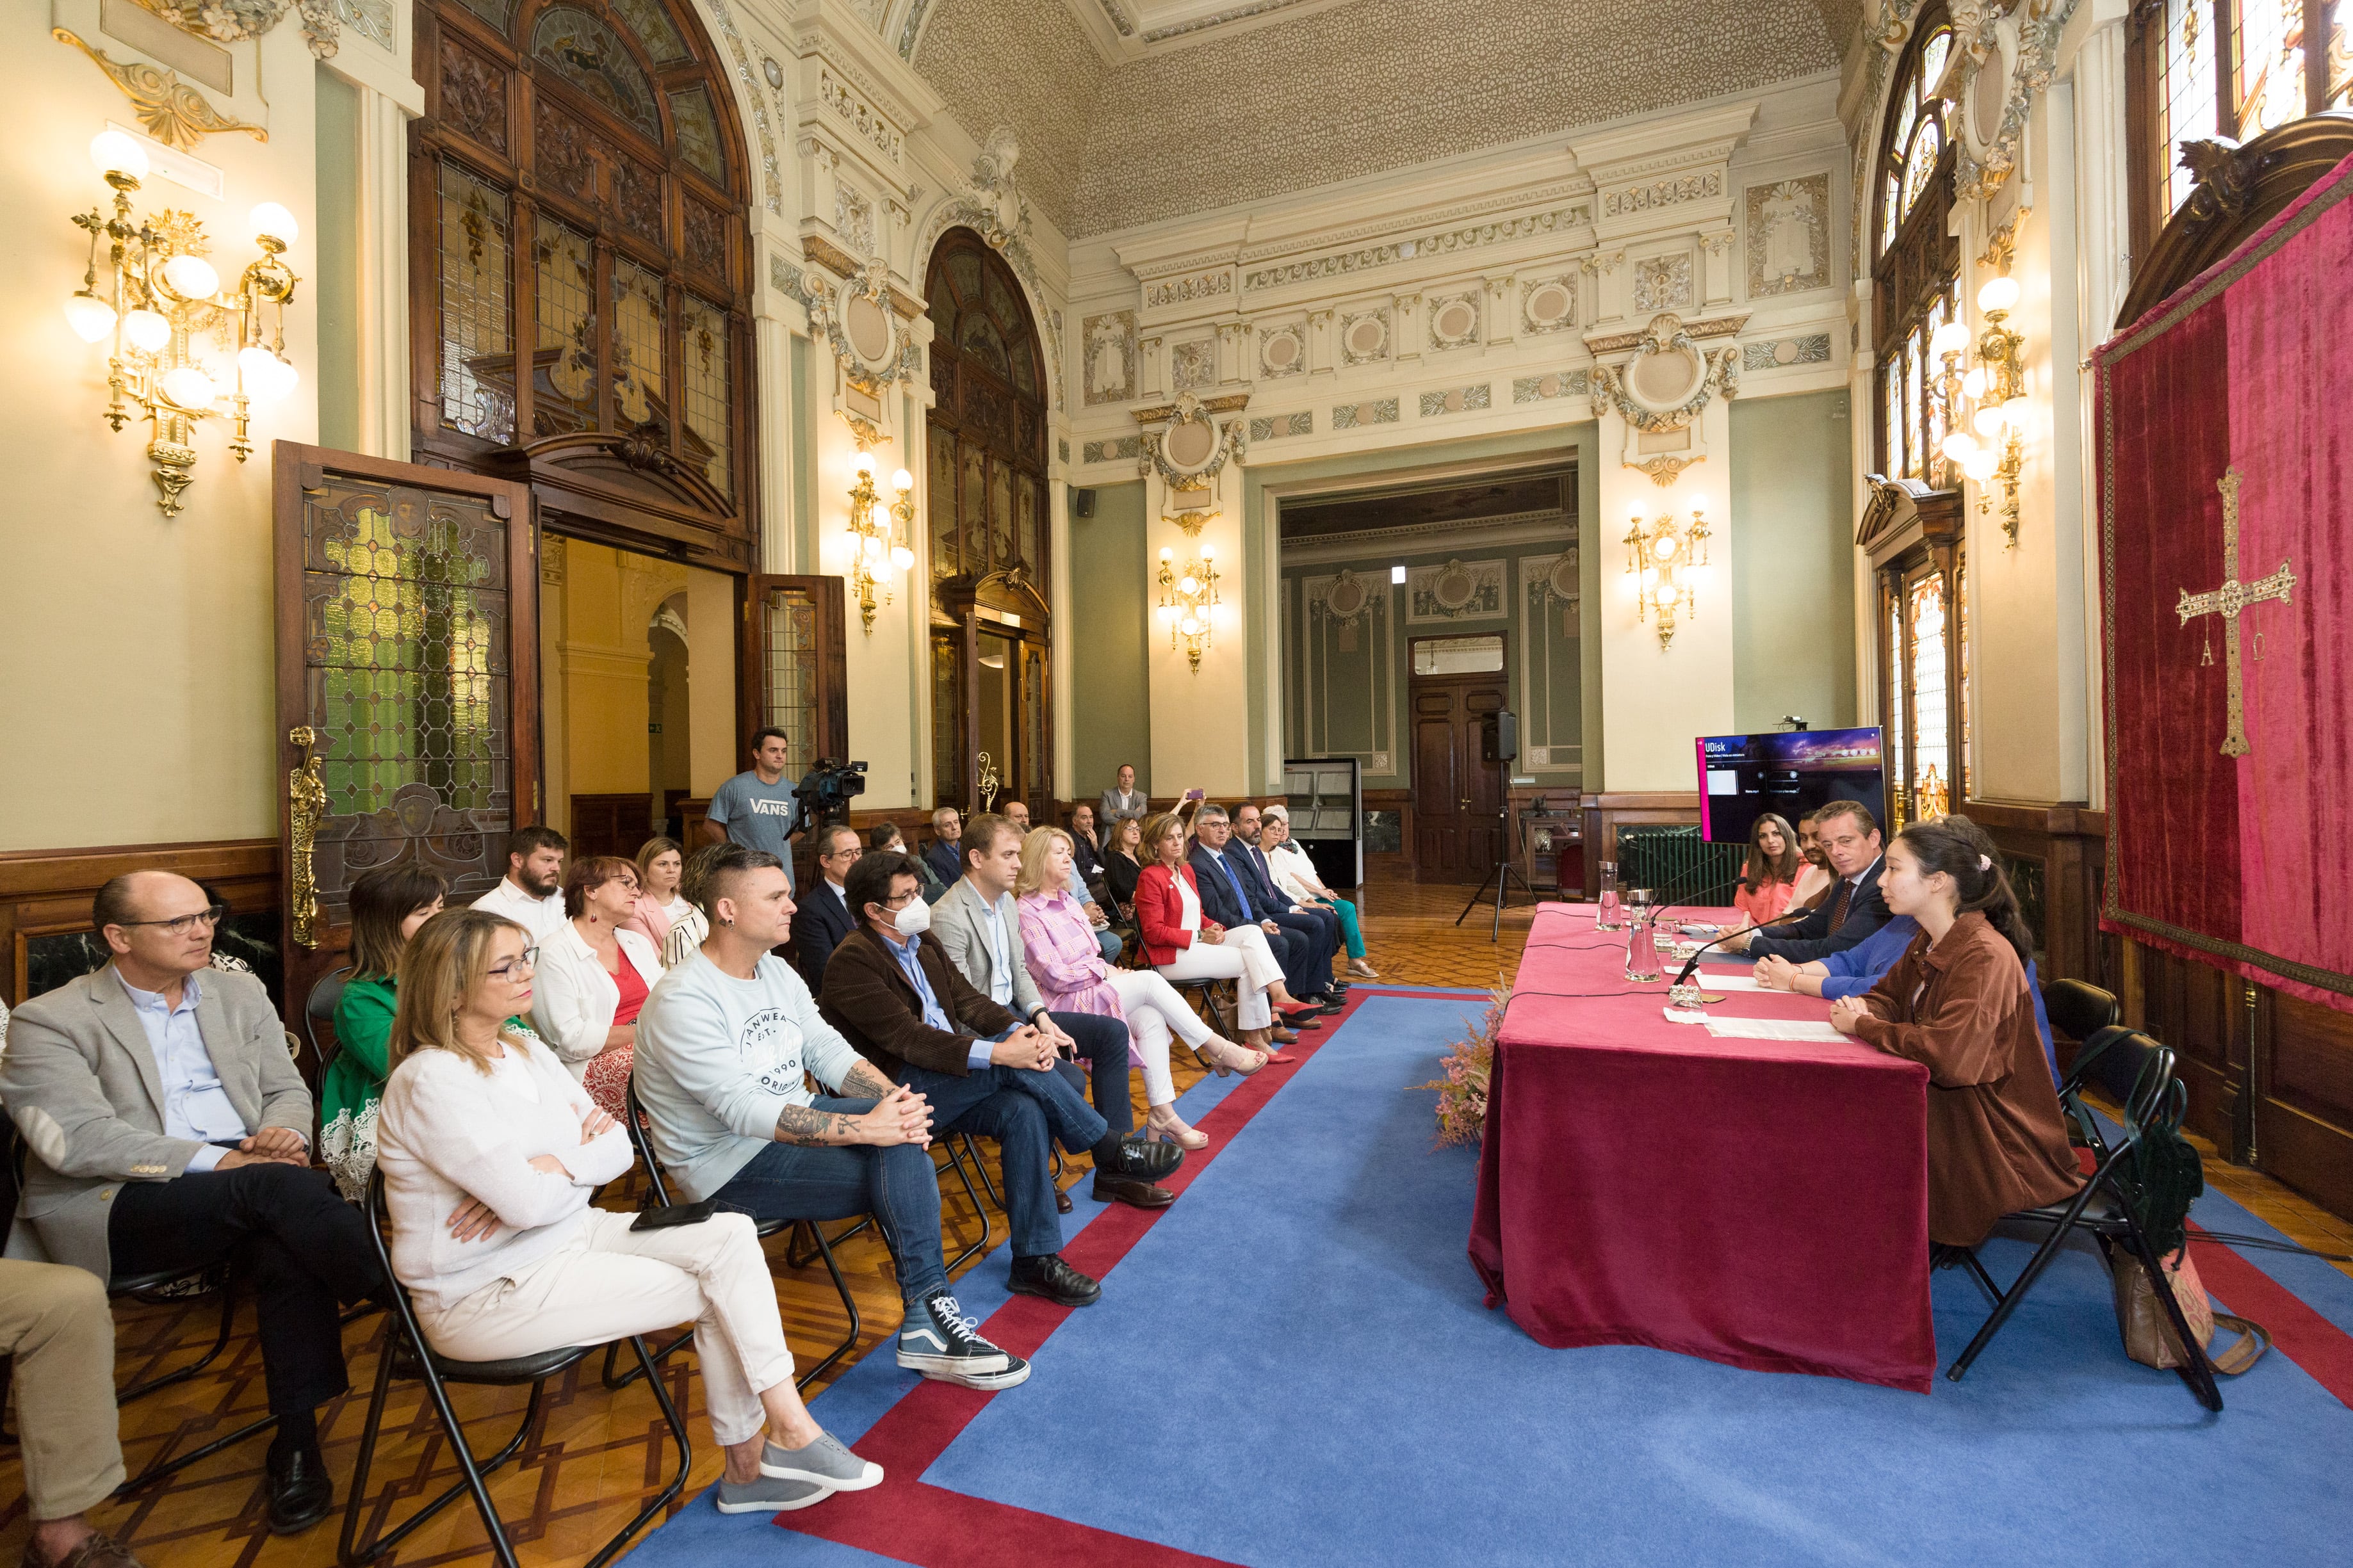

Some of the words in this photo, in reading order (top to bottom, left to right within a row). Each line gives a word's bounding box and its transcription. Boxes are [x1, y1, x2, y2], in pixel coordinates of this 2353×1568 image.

[1705, 741, 1726, 752] UDisk
[749, 798, 788, 816] VANS
[769, 1060, 795, 1075] 1990
